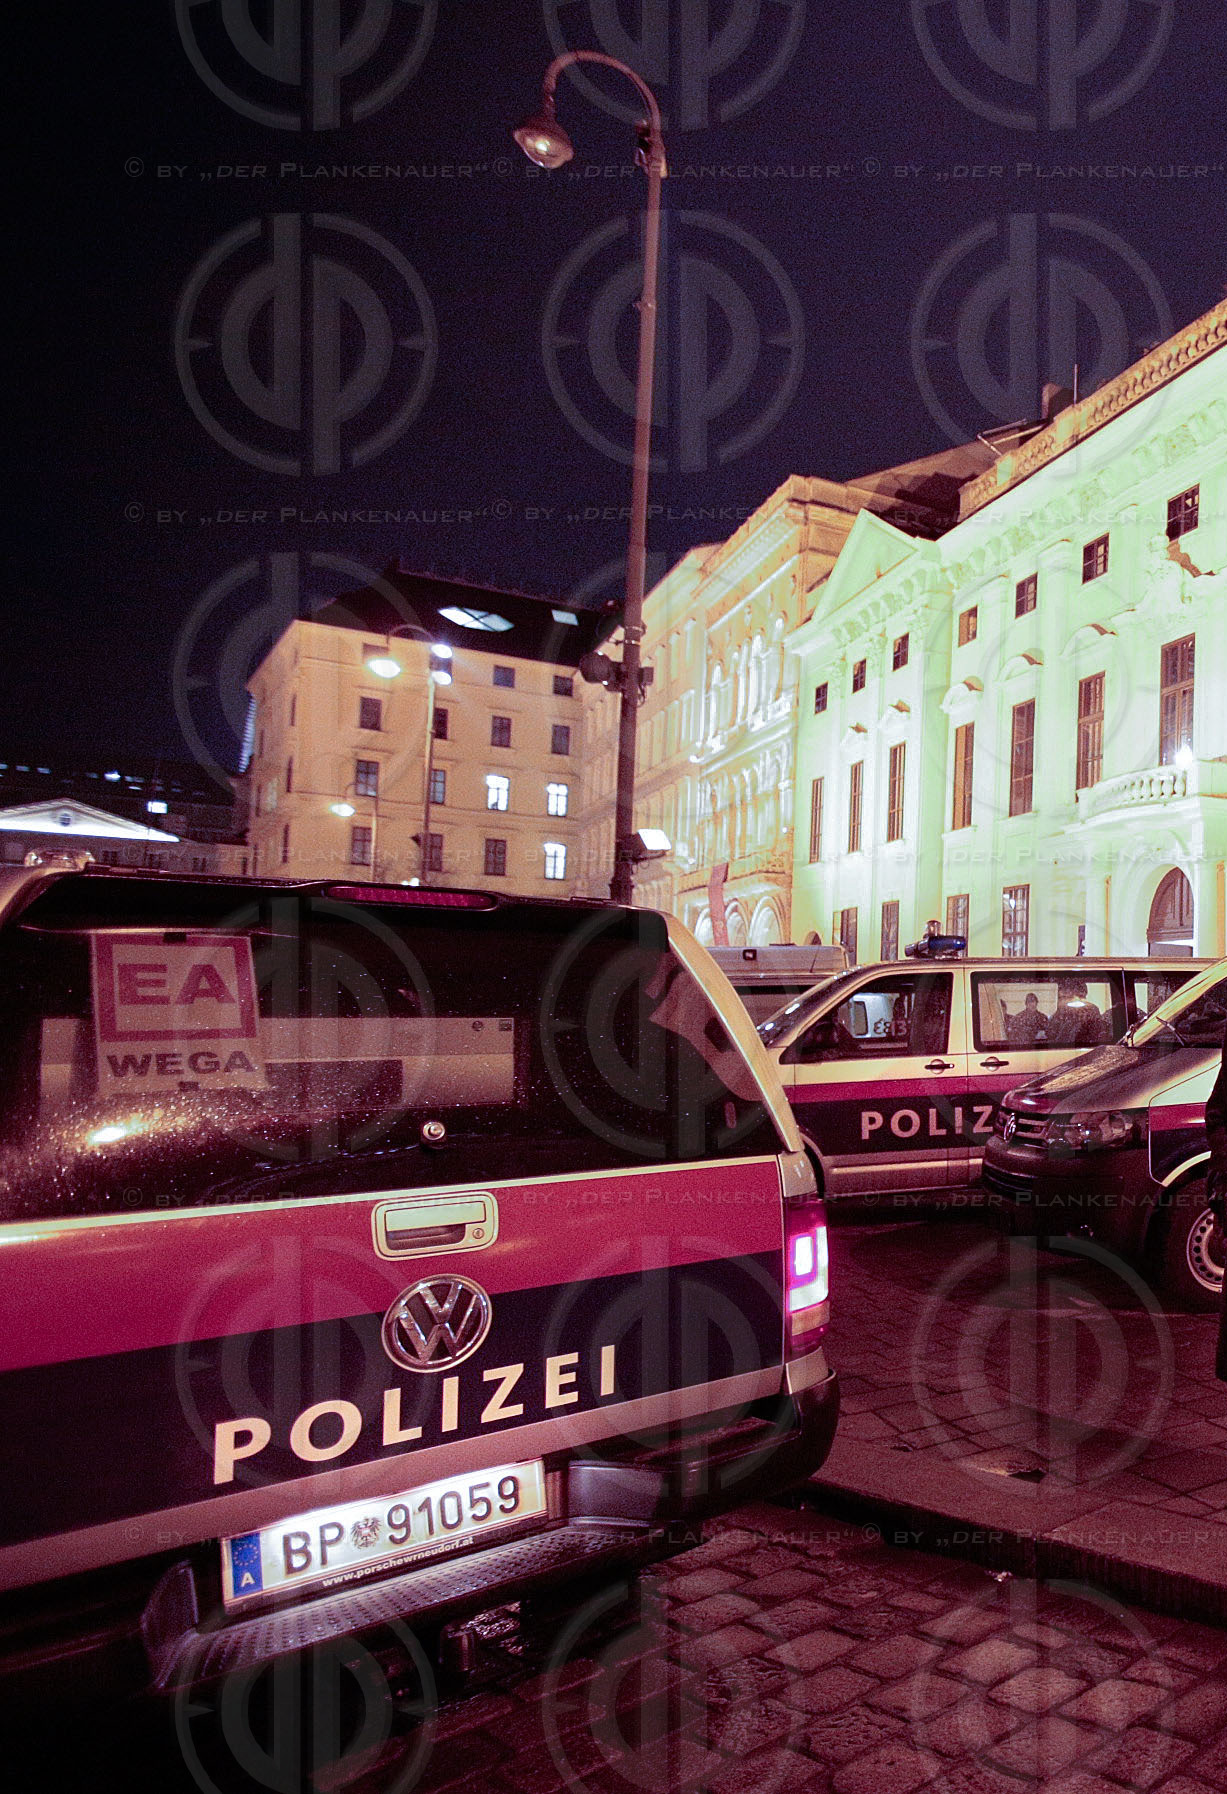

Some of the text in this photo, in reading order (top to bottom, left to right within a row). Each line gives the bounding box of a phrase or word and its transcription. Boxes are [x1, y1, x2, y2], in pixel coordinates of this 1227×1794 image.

[116, 962, 236, 1006] EA
[106, 1050, 255, 1078] WEGA
[213, 1344, 615, 1485] POLIZEI
[282, 1474, 521, 1577] BP 91059
